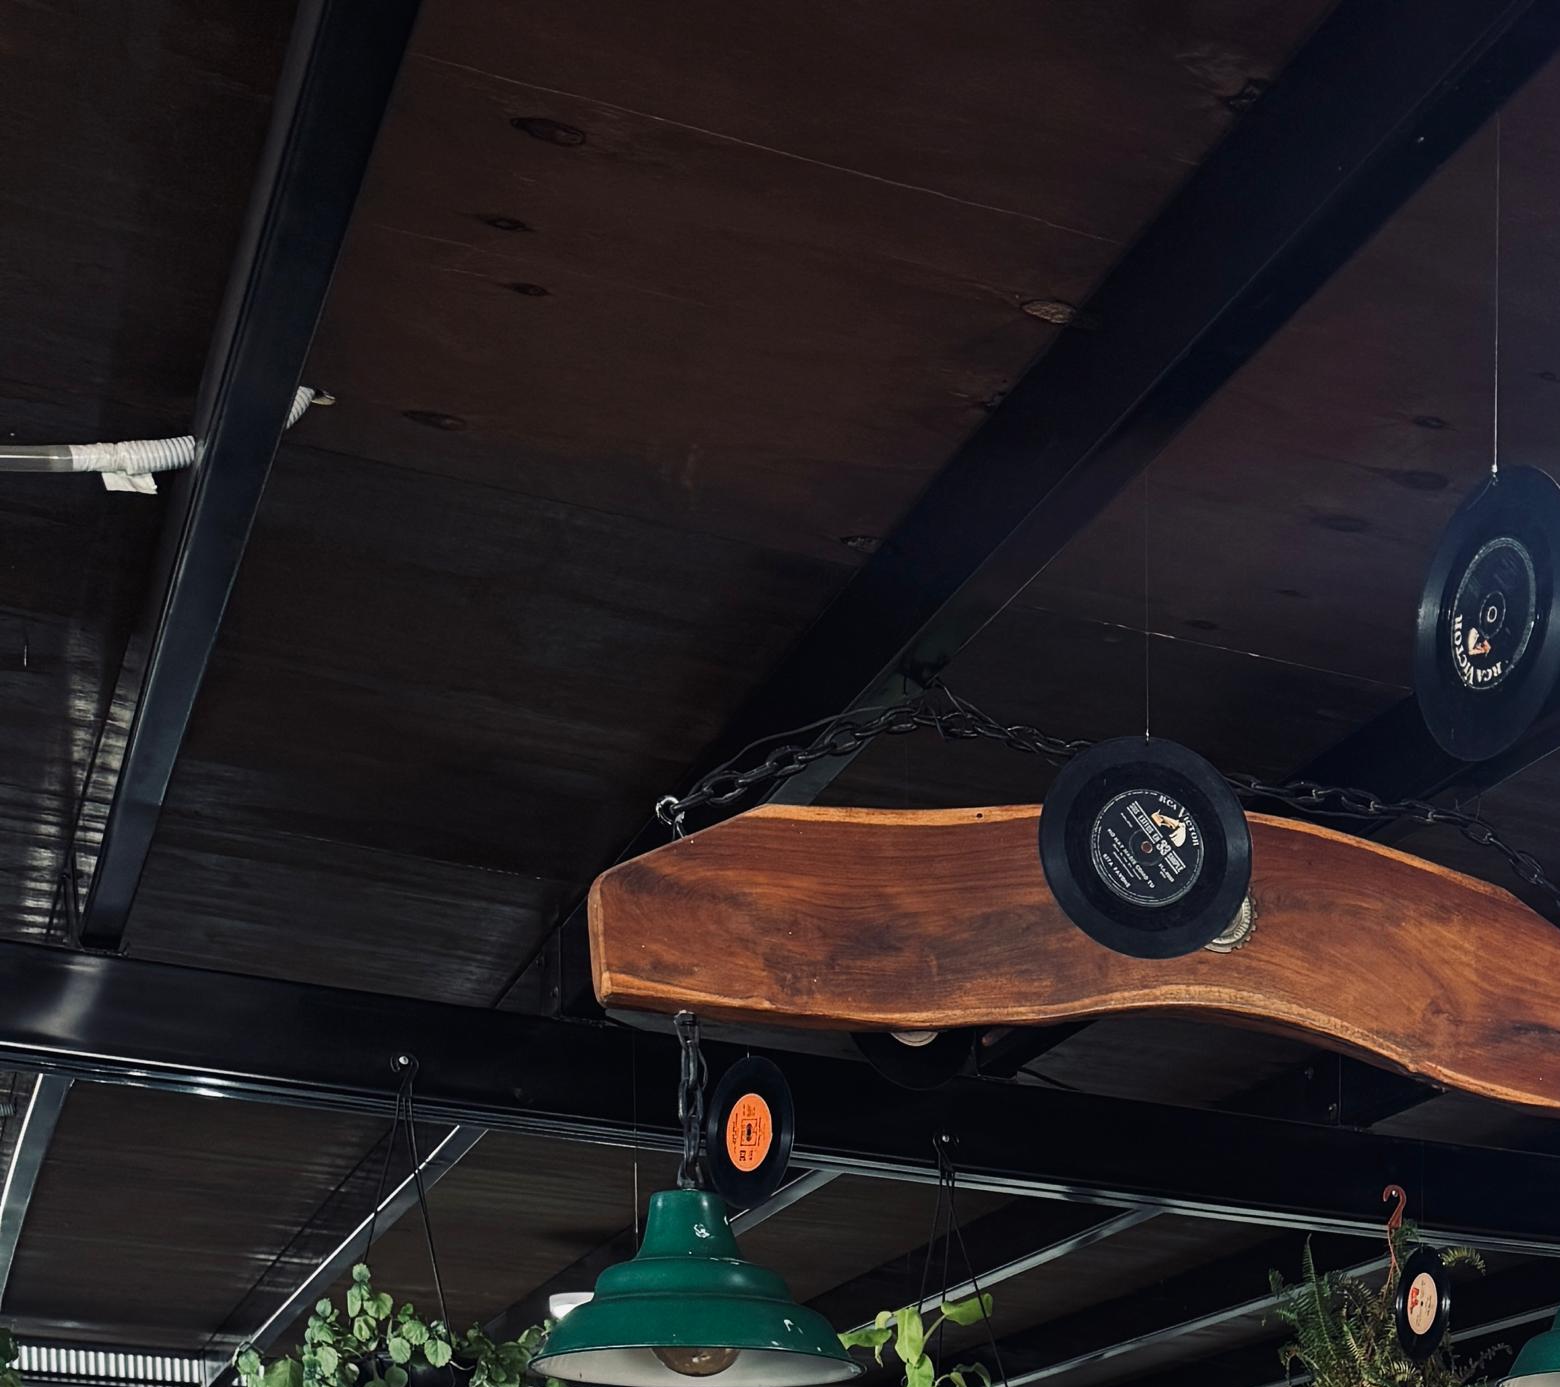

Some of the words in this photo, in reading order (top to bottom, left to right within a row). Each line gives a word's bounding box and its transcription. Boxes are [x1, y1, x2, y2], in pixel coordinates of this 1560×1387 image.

[1476, 661, 1501, 683] RCA
[1159, 795, 1177, 811] RCA
[1178, 806, 1200, 846] VICTOR
